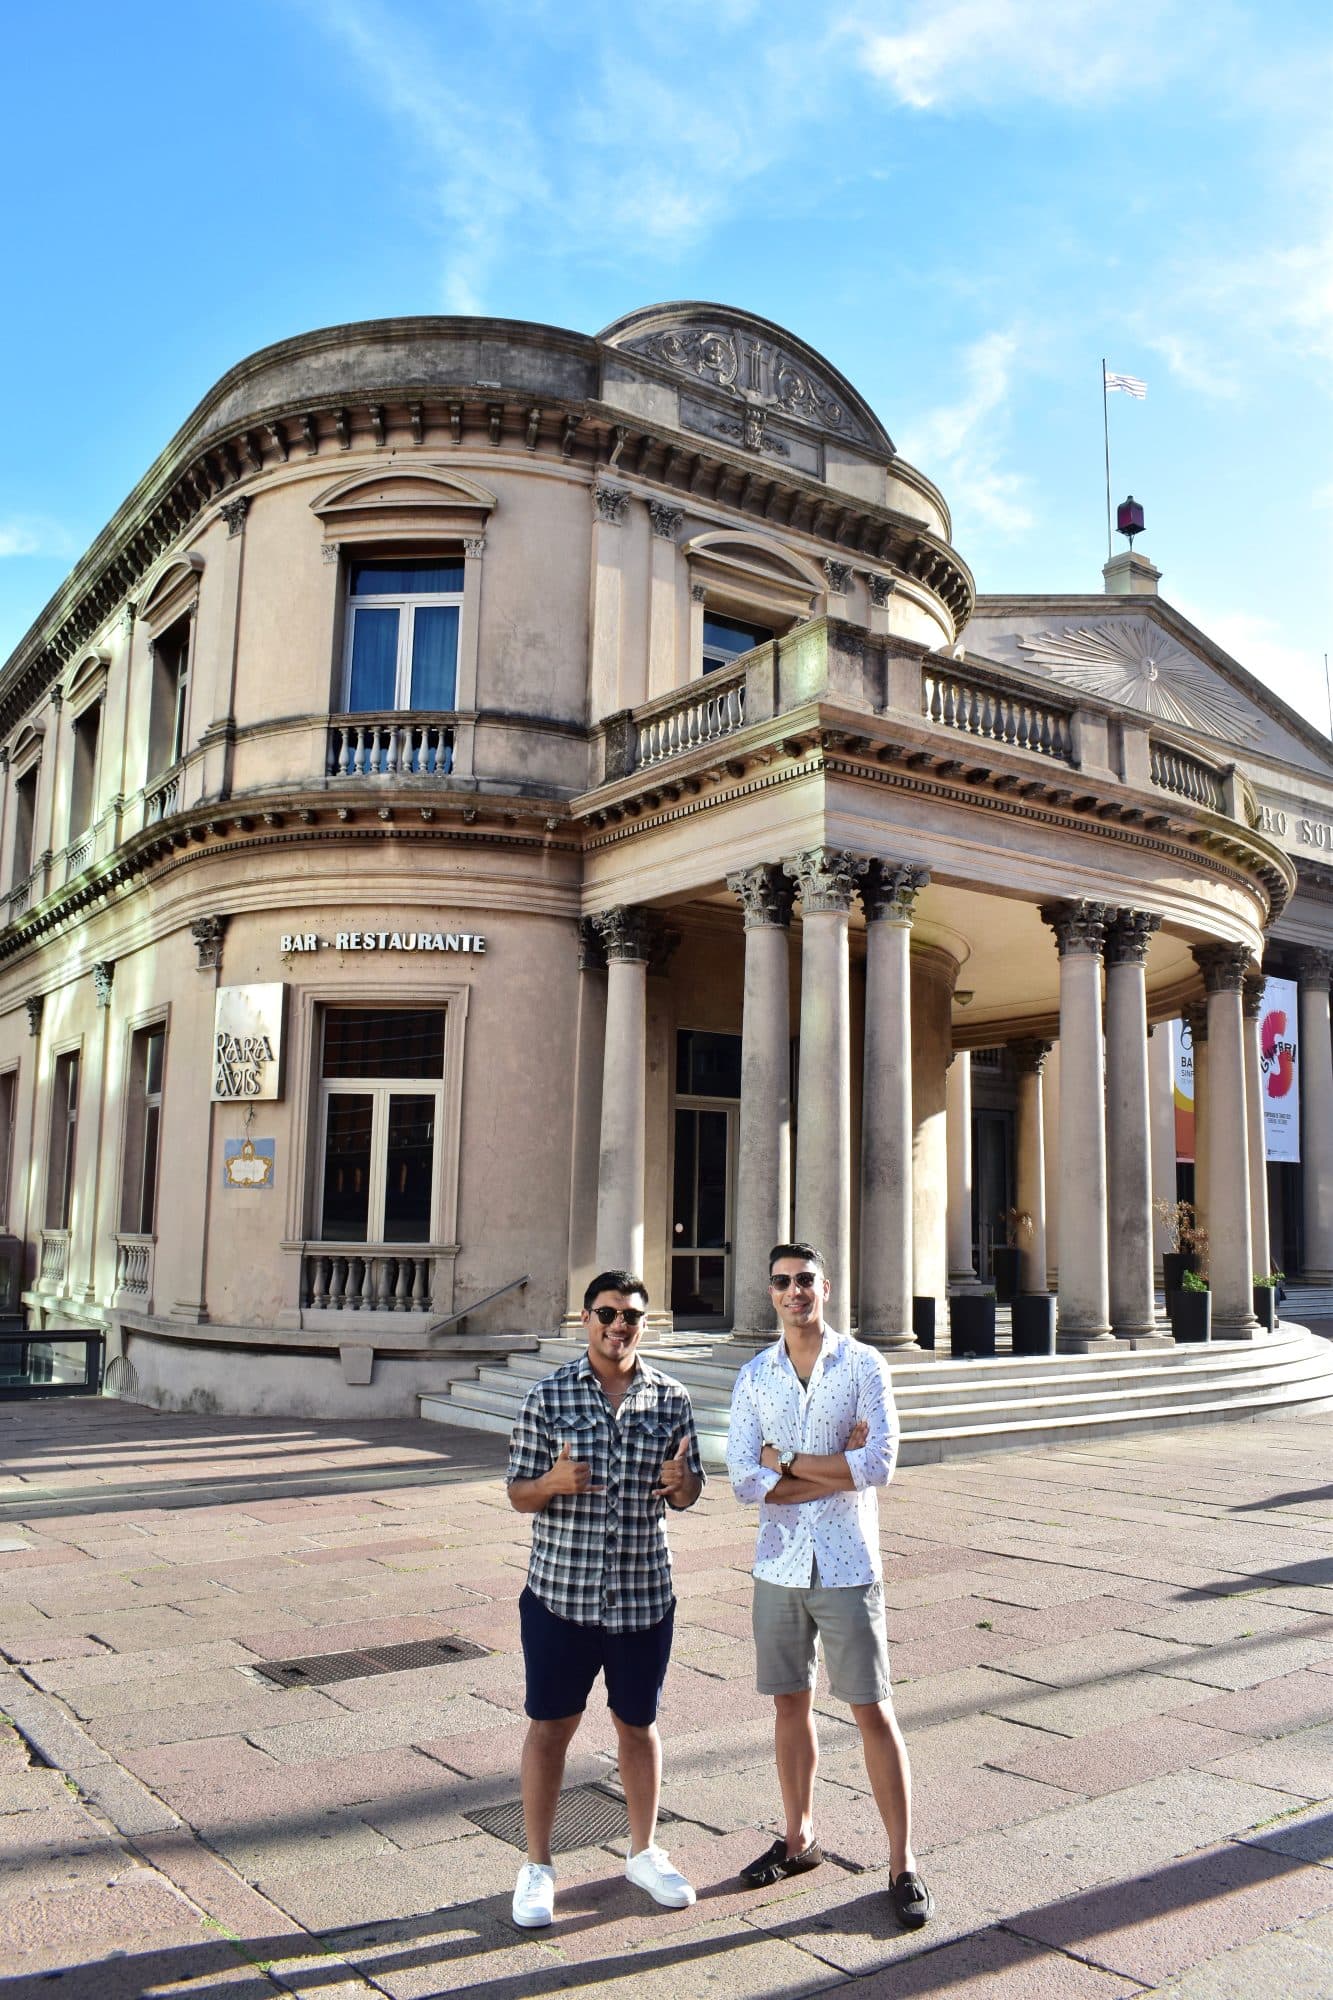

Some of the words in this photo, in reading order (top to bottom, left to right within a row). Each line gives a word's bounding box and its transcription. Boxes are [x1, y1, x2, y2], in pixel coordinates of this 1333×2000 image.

[280, 933, 318, 952] BAR
[335, 931, 486, 953] RESTAURANTE
[216, 1032, 274, 1068] RARA
[215, 1065, 262, 1096] AVIS
